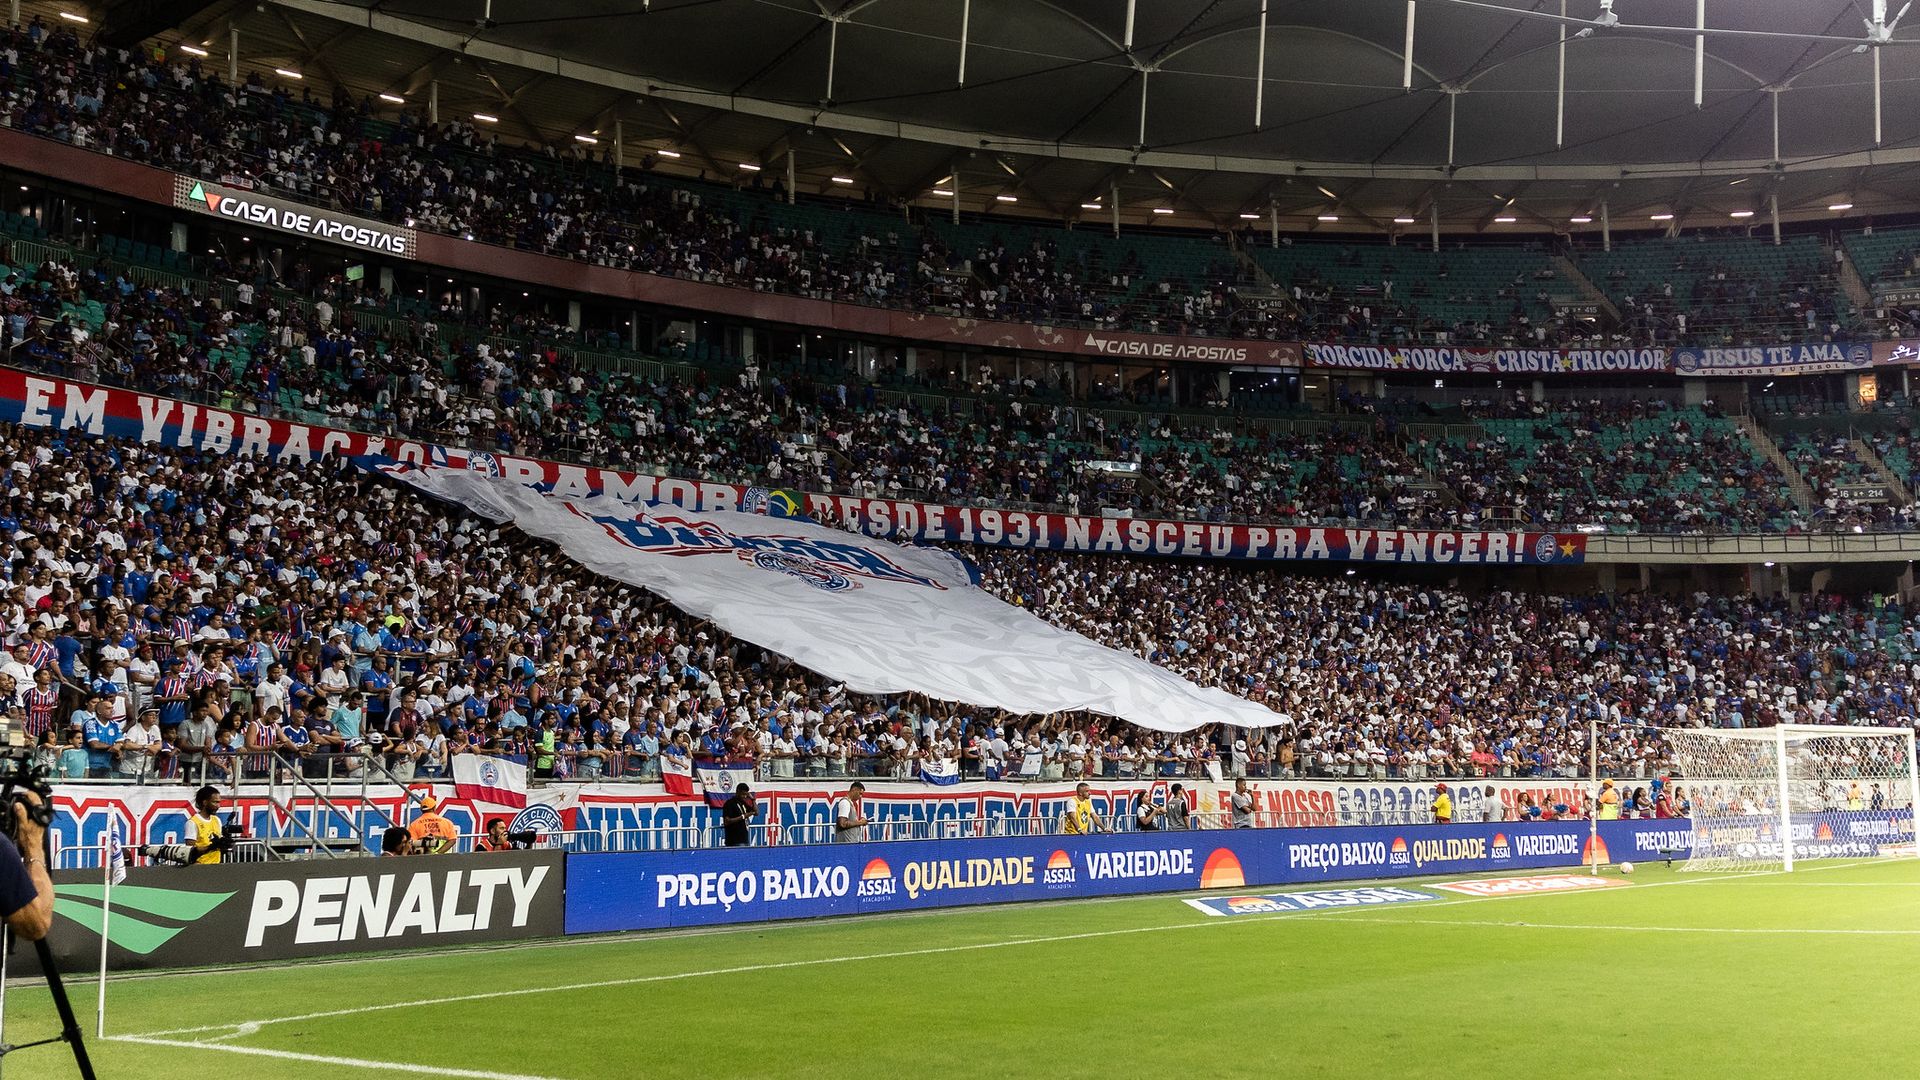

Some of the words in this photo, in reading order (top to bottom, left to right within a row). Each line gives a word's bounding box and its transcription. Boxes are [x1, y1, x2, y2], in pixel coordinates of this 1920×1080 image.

[219, 197, 279, 226] CASA
[281, 210, 311, 233] DE
[312, 219, 406, 253] APOSTAS
[1106, 340, 1149, 356] CASA
[1152, 343, 1173, 357] DE
[1174, 345, 1247, 361] APOSTAS
[1308, 344, 1399, 370] TORCIDA
[1399, 348, 1468, 372] FORÇA
[1496, 350, 1566, 373] CRISTÃ
[1568, 349, 1667, 372] TRICOLOR
[1701, 348, 1765, 367] JESUS
[1767, 347, 1794, 365] TE
[1798, 344, 1845, 363] AMA
[21, 376, 108, 435] EM
[959, 508, 1050, 548] 1931
[1064, 517, 1233, 557] NASCEU
[1246, 528, 1330, 559] PRA
[1345, 530, 1525, 562] VENCER!
[1868, 489, 1884, 497] 214
[1267, 789, 1337, 827] NOSSO
[1526, 783, 1587, 818] TAMBÉ
[530, 810, 557, 828] CLUBE
[1289, 843, 1339, 872] PREÇO
[1342, 841, 1386, 866] BAIXO
[1413, 838, 1487, 868] QUALIDADE
[1515, 834, 1579, 856] VARIEDADE
[1635, 830, 1668, 854] PREÇO
[1668, 829, 1696, 850] BAIXO
[903, 856, 1035, 900] QUALIDADE
[1085, 849, 1194, 881] VARIEDADE
[656, 870, 757, 913] PREÇO
[762, 865, 850, 902] BAIXO
[862, 895, 891, 903] ATACADISTA
[244, 865, 550, 948] PENALTY
